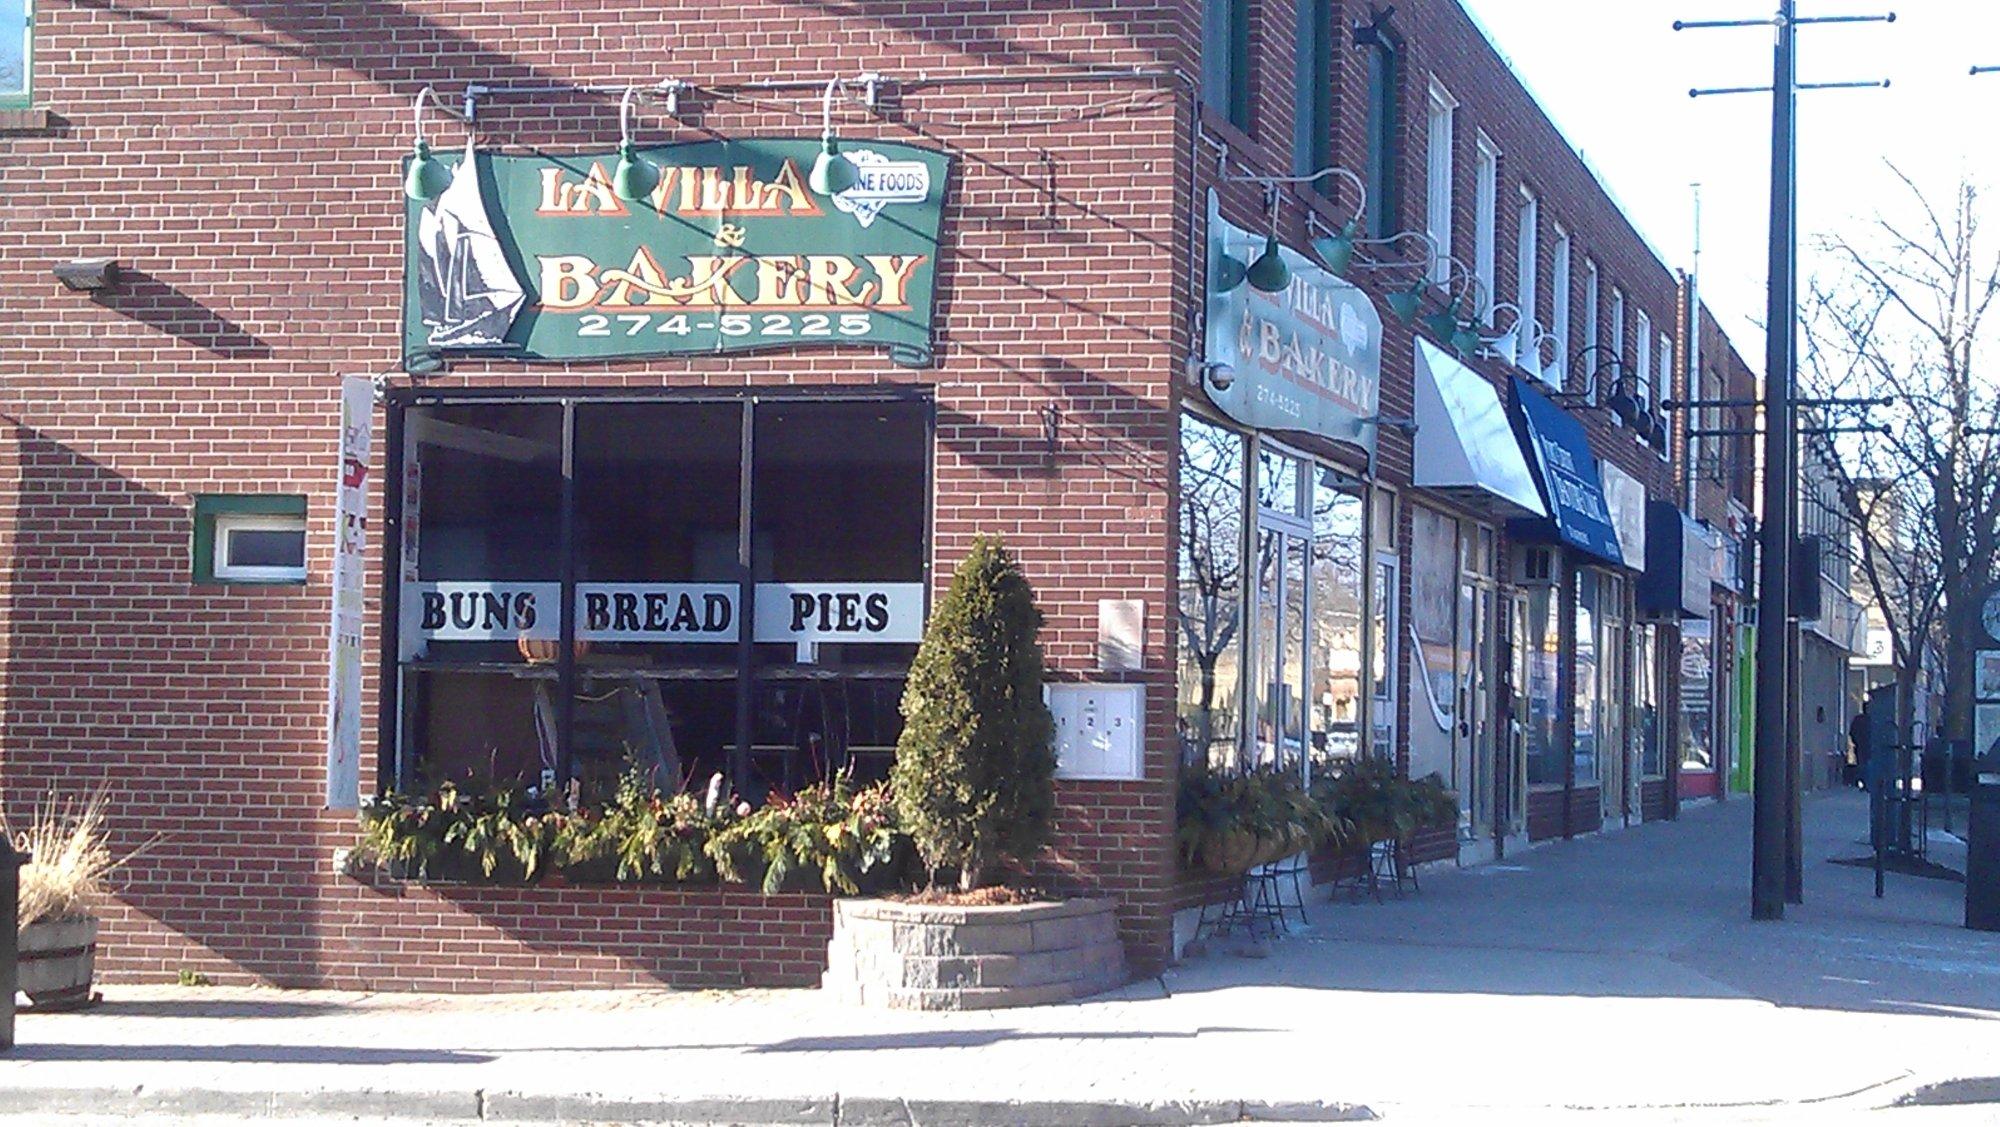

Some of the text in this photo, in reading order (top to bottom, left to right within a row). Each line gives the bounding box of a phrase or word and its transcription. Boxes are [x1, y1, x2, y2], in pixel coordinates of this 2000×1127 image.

[534, 158, 823, 220] LA VILLA
[879, 173, 924, 192] FOODS
[714, 223, 746, 247] &
[533, 245, 925, 312] BAKERY
[577, 313, 873, 336] 274-5225
[1239, 308, 1373, 413] & BAKERY
[420, 591, 537, 630] BUNS
[584, 592, 733, 632] BREAD
[789, 592, 890, 632] PIES
[1086, 717, 1095, 727] 2
[1114, 717, 1122, 728] 3
